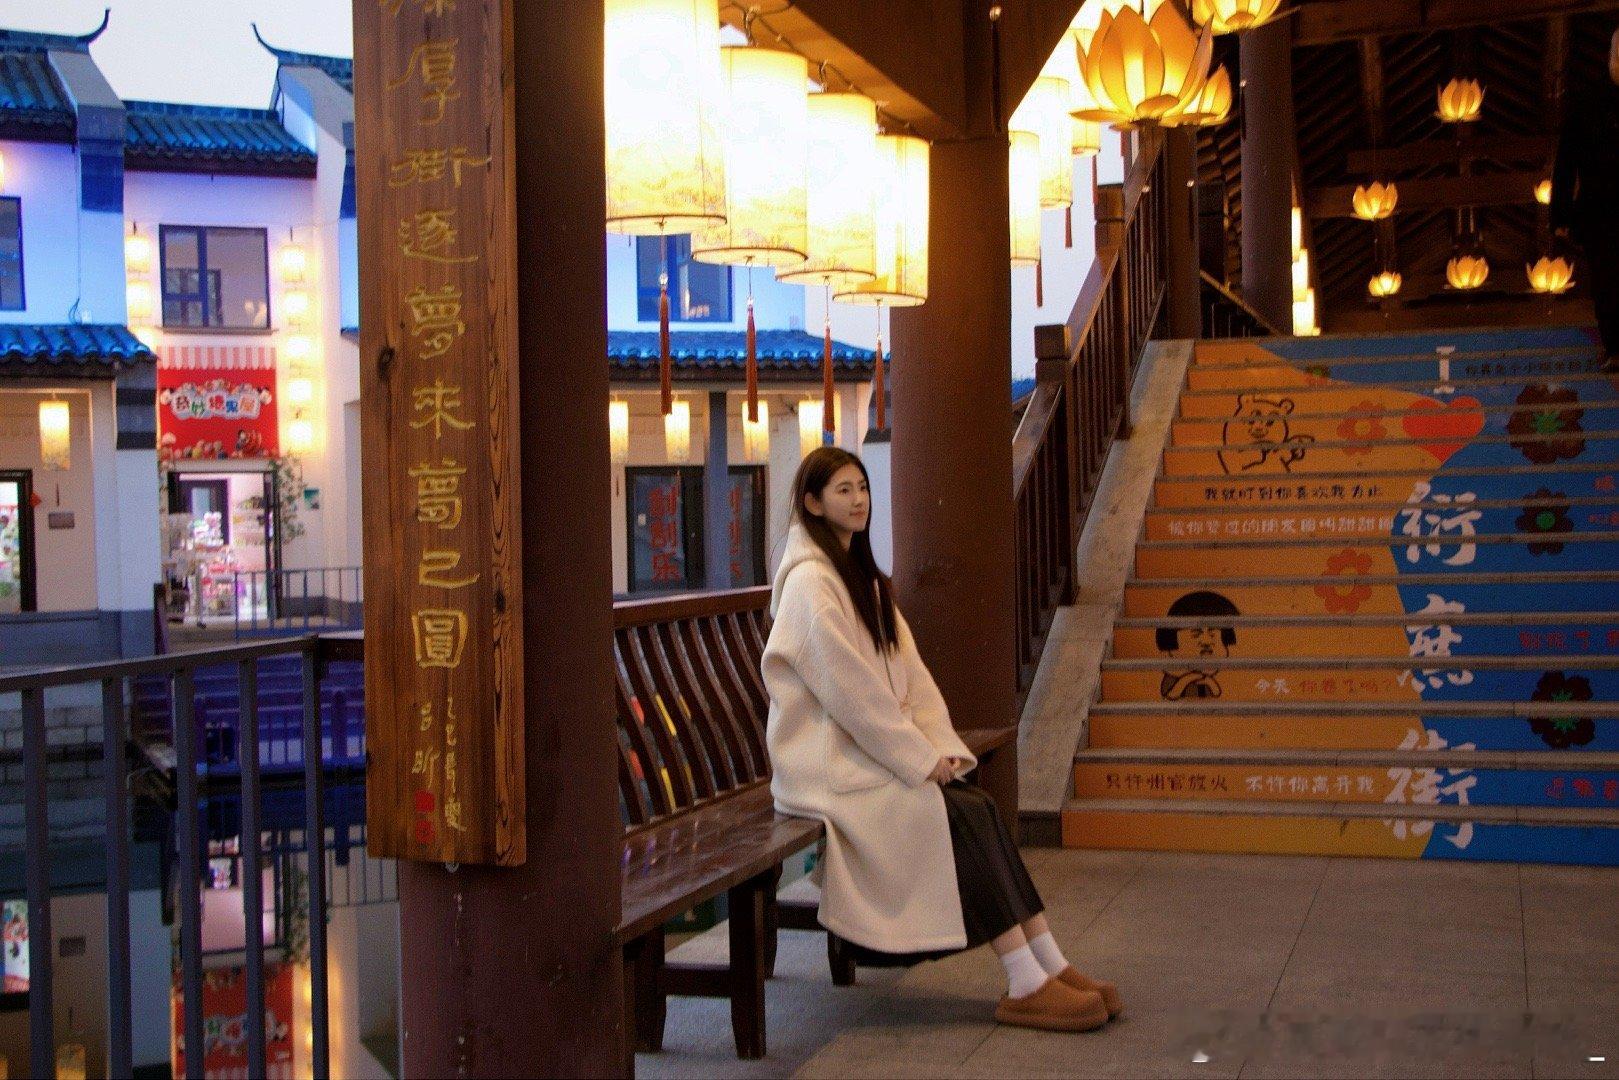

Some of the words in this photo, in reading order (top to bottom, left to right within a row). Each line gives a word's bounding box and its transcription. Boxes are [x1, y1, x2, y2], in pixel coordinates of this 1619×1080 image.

[1244, 774, 1374, 794] 不许你离开我
